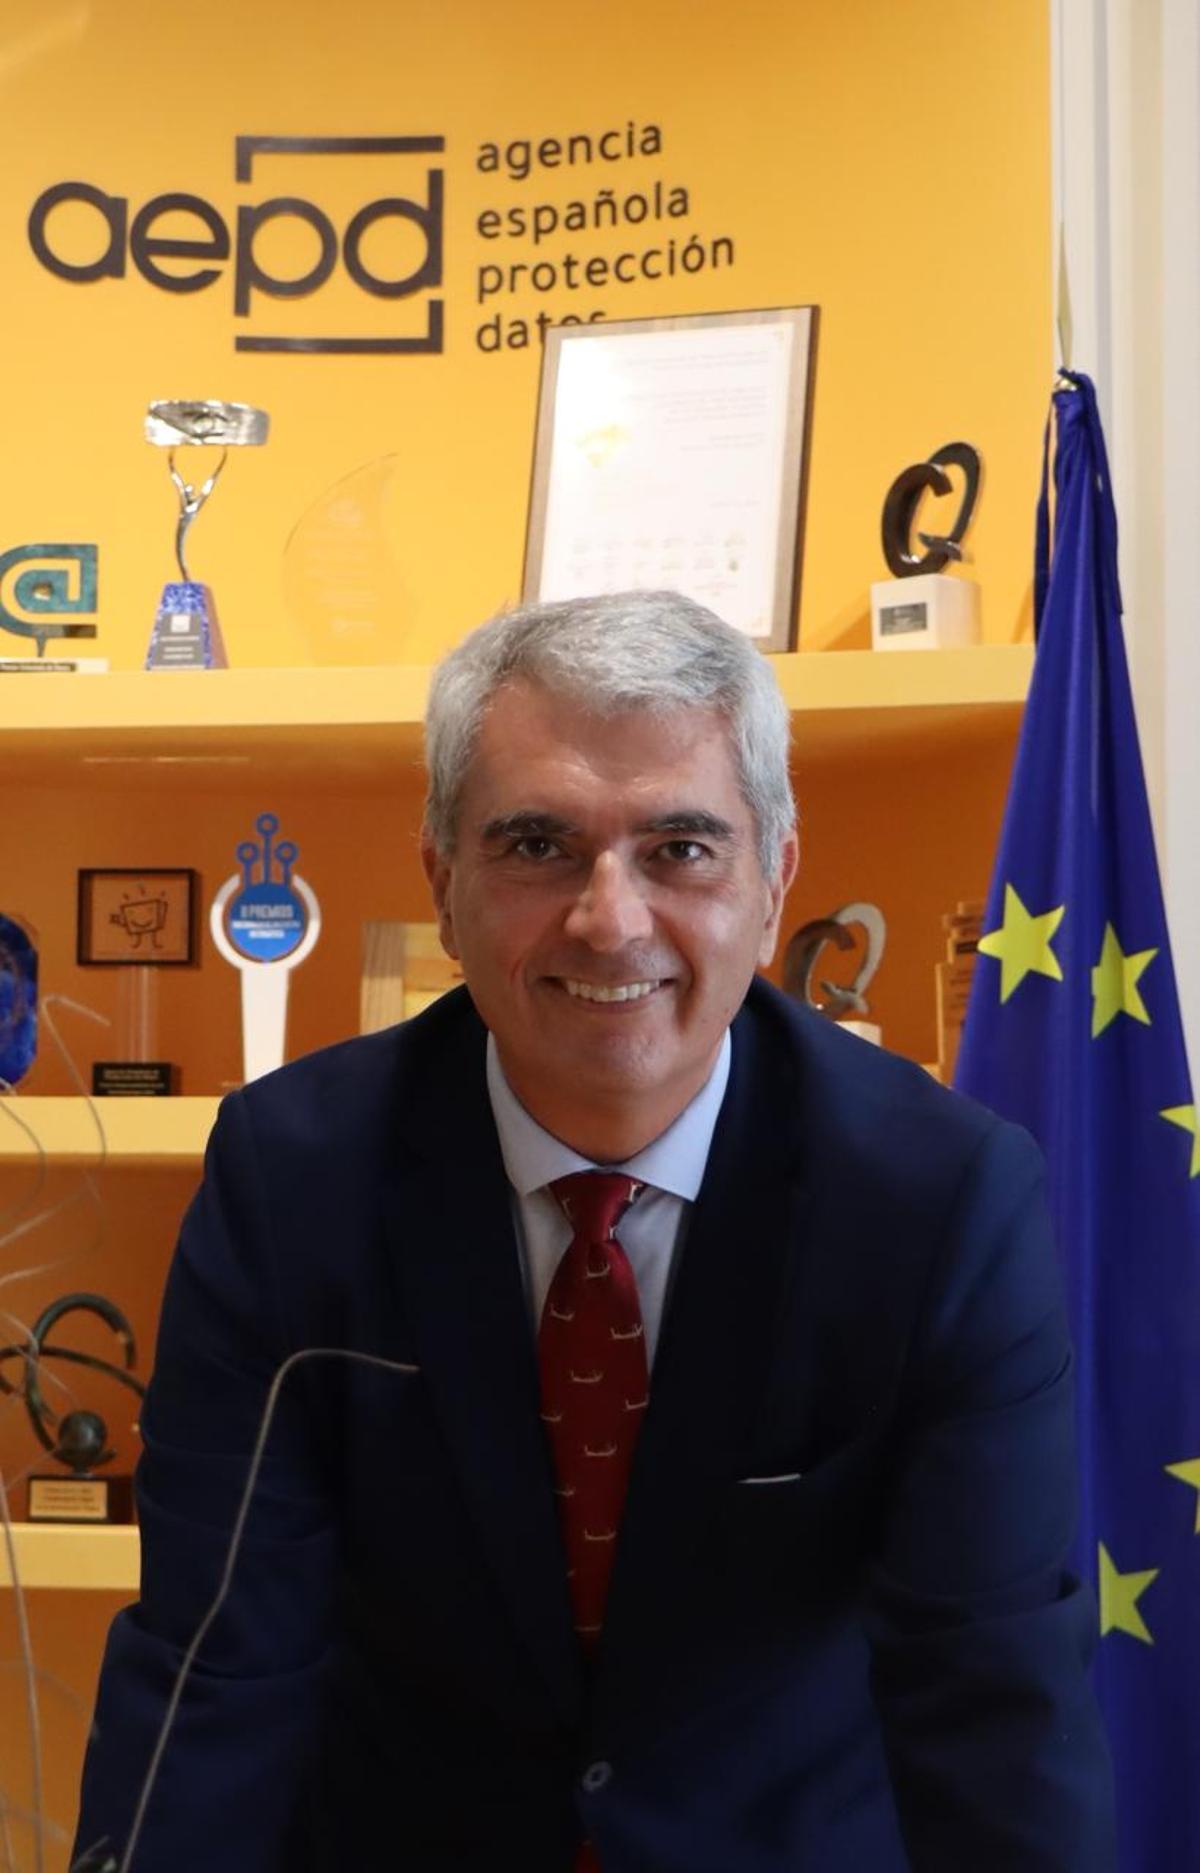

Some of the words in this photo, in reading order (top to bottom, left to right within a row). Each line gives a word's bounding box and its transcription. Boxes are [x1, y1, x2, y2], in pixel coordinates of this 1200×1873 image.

[476, 121, 662, 180] agencia
[27, 168, 444, 318] aepd
[476, 180, 689, 245] española
[477, 234, 735, 304] protección
